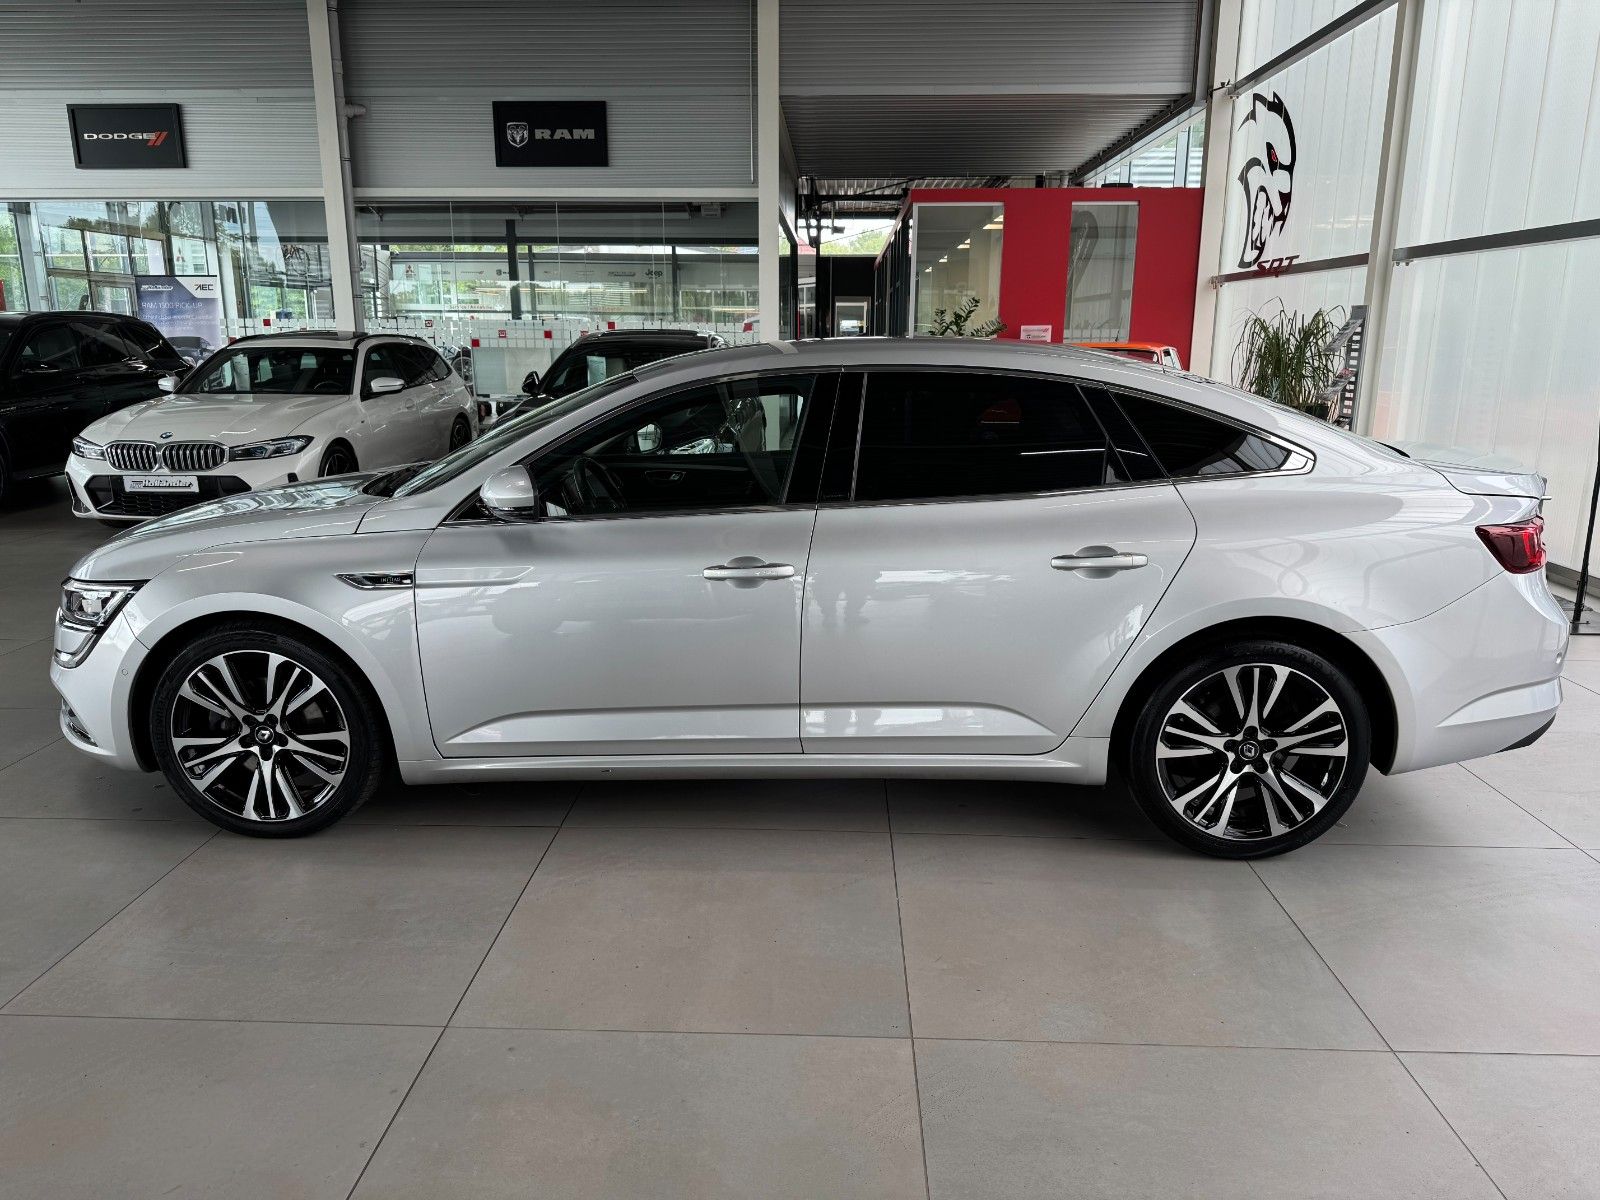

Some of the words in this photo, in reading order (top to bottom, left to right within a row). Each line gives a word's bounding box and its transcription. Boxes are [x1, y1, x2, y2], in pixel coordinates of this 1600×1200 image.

[83, 132, 158, 141] DODGE
[535, 129, 595, 140] RAM
[1256, 255, 1299, 277] SRT
[645, 269, 663, 278] Jeep
[194, 283, 214, 291] AEC
